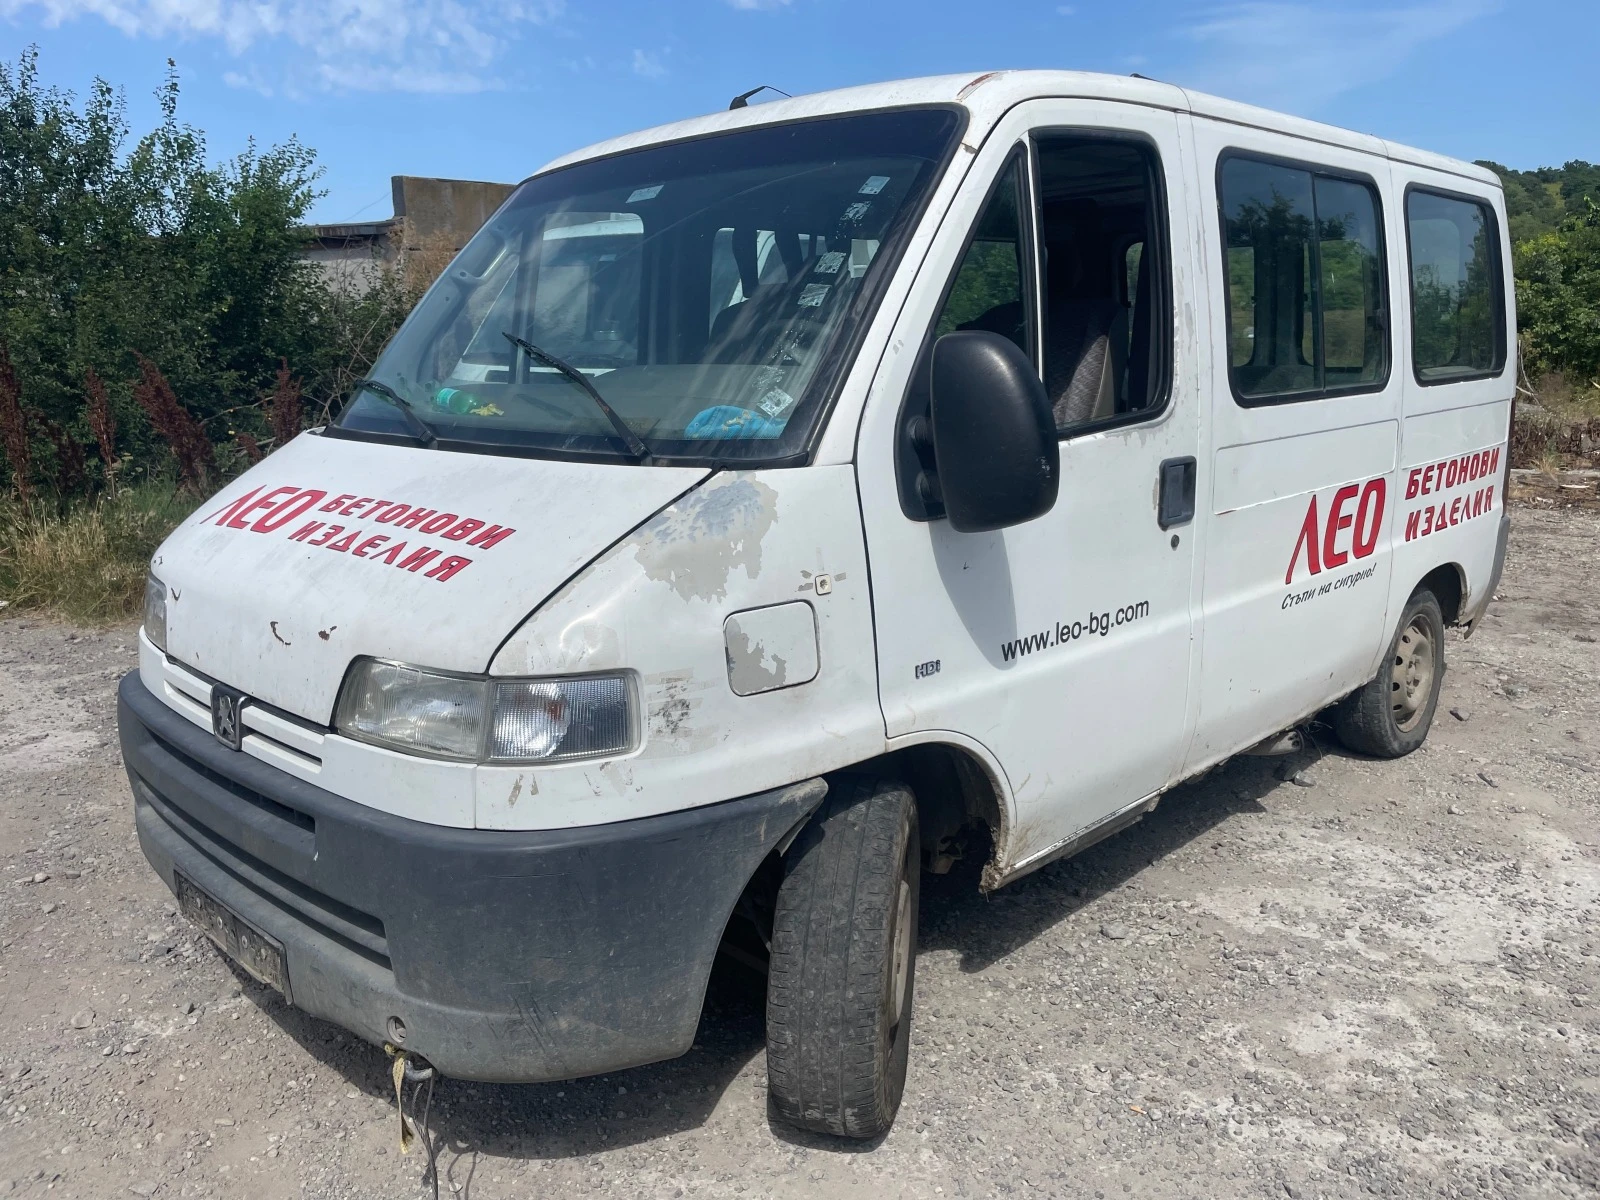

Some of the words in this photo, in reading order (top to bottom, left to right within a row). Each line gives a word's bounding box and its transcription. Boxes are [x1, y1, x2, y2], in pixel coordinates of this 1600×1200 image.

[1405, 447, 1500, 500] БЕТОНОВИ
[200, 485, 328, 534] ЛЕО
[318, 494, 517, 550] БЕТОНОВИ
[1285, 477, 1387, 585] ЛЕО
[1404, 485, 1495, 542] ИЗДЕЛИЯ
[288, 521, 473, 582] ИЗДЕЛИЯ
[1281, 587, 1317, 610] Стъпи
[1318, 582, 1332, 596] на
[1333, 562, 1377, 589] сигурно!
[1001, 600, 1149, 662] www.leo-bg.com
